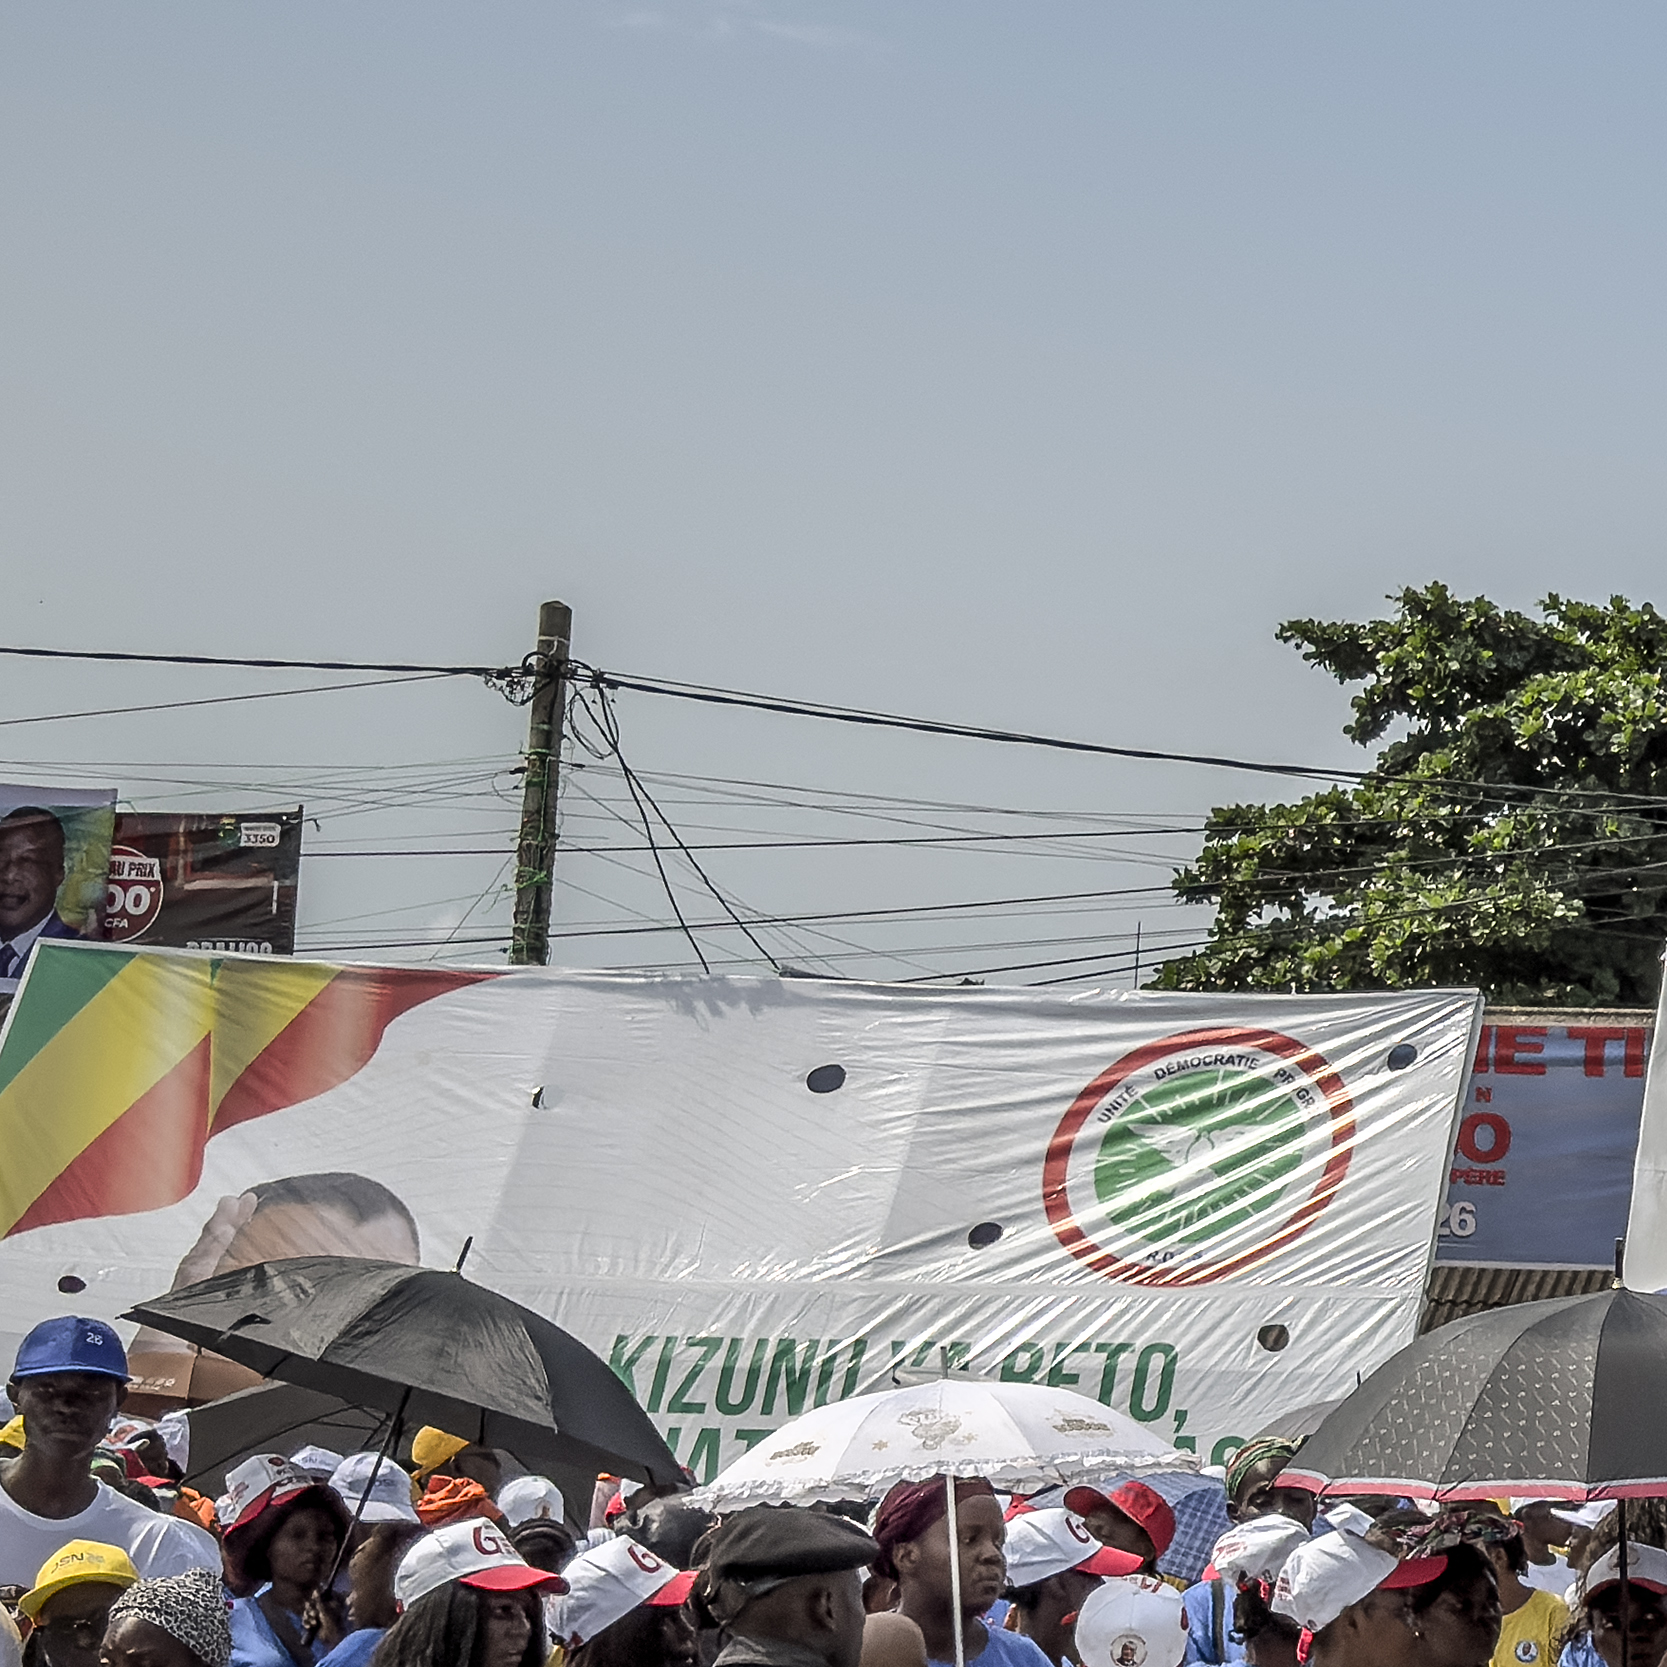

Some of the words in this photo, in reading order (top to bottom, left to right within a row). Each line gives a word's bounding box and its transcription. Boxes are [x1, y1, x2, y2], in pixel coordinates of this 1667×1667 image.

[127, 863, 156, 878] PRIX
[1096, 1085, 1140, 1124] UNITÉ
[1153, 1053, 1260, 1081] DÉMOCRATIE
